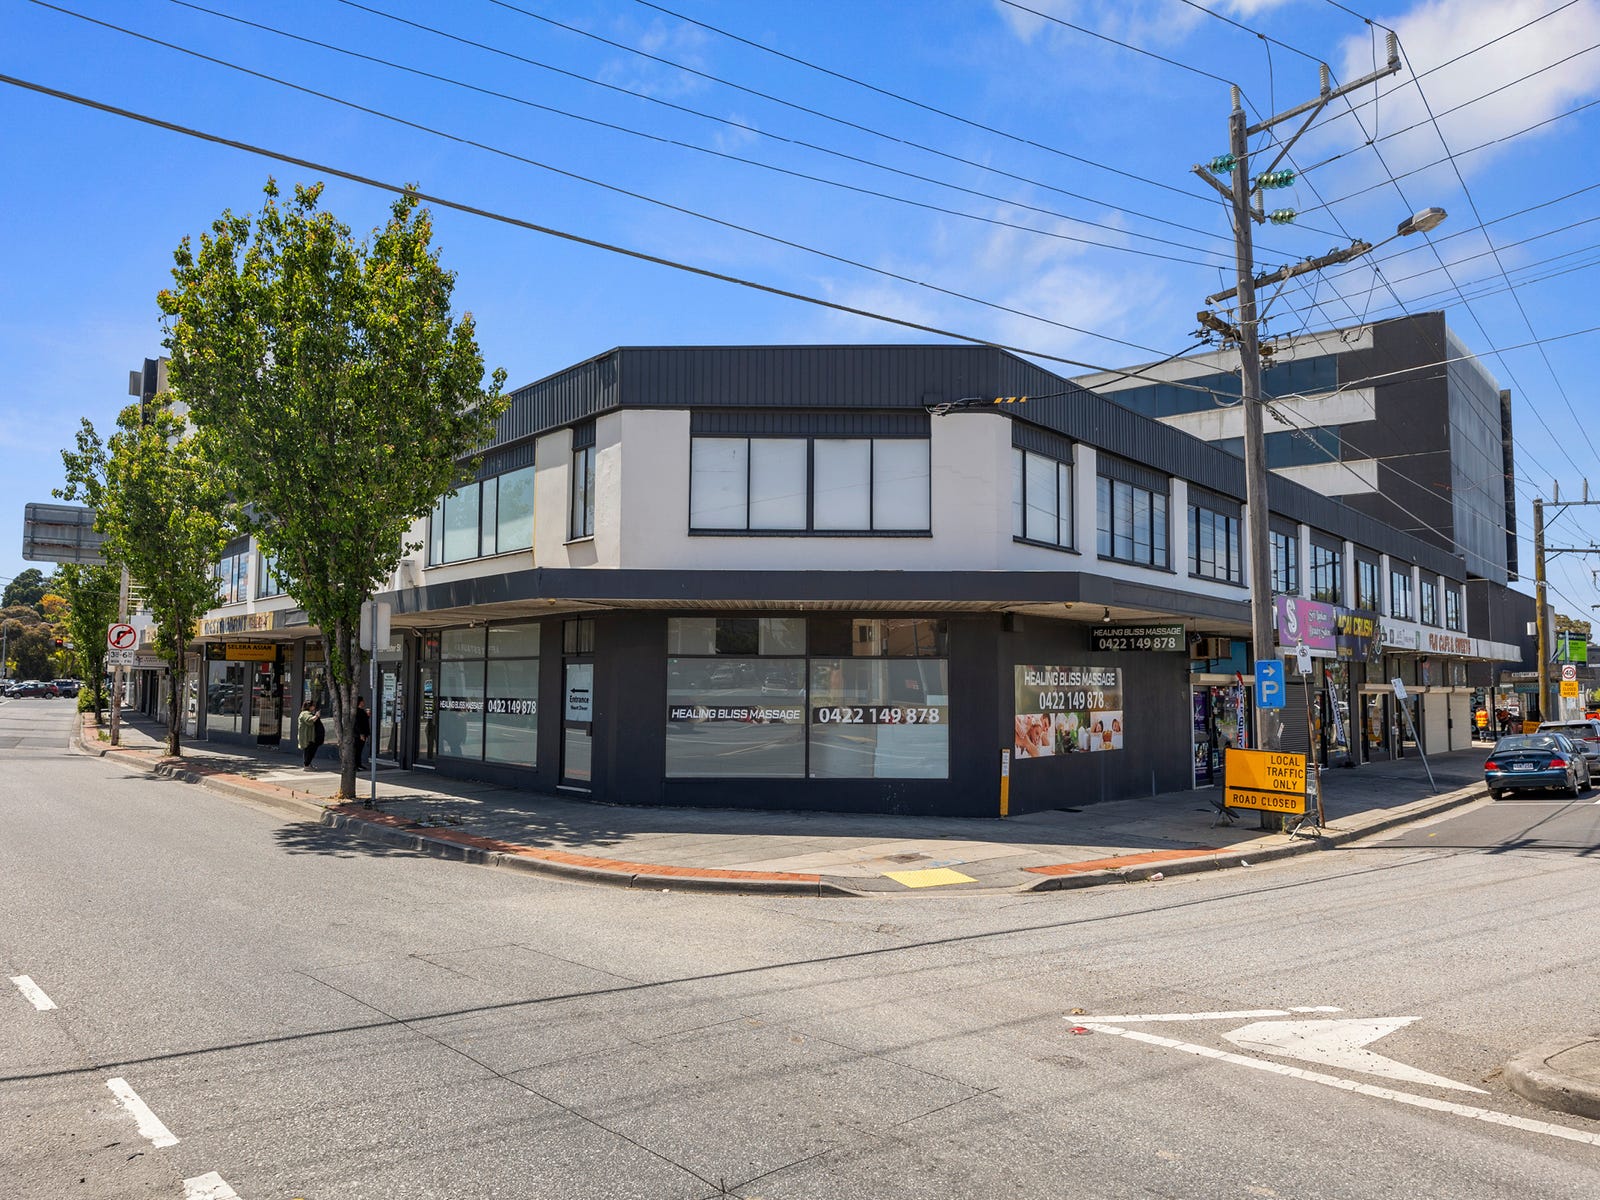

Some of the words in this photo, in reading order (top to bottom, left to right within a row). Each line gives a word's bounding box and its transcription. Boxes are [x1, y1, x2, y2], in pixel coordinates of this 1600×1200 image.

[1093, 628, 1123, 637] HEALING
[1124, 628, 1145, 636] BLISS
[1145, 627, 1181, 635] MASSAGE
[1353, 616, 1373, 637] CRUSH
[1099, 638, 1127, 649] 0422
[1129, 638, 1151, 649] 149
[1153, 637, 1176, 649] 878
[1024, 672, 1059, 686] HEALING
[1060, 672, 1081, 686] BLISS
[1081, 672, 1116, 686] MASSAGE
[1261, 681, 1279, 703] P
[569, 695, 589, 704] Entrance
[1039, 691, 1065, 710] 0422
[1067, 691, 1086, 710] 149
[1086, 691, 1105, 709] 878
[487, 700, 506, 713] 0422
[507, 700, 521, 713] 149
[521, 701, 537, 714] 878
[671, 708, 716, 719] HEALING
[717, 709, 748, 719] BLISS
[749, 709, 801, 719] MASSAGE
[818, 708, 864, 723] 0422
[869, 708, 903, 723] 149
[905, 708, 940, 723] 878
[1270, 755, 1301, 767] LOCAL
[1266, 766, 1304, 779] TRAFFIC
[1272, 778, 1298, 790] ONLY
[1232, 793, 1257, 805] ROAD
[1261, 796, 1297, 809] CLOSED
